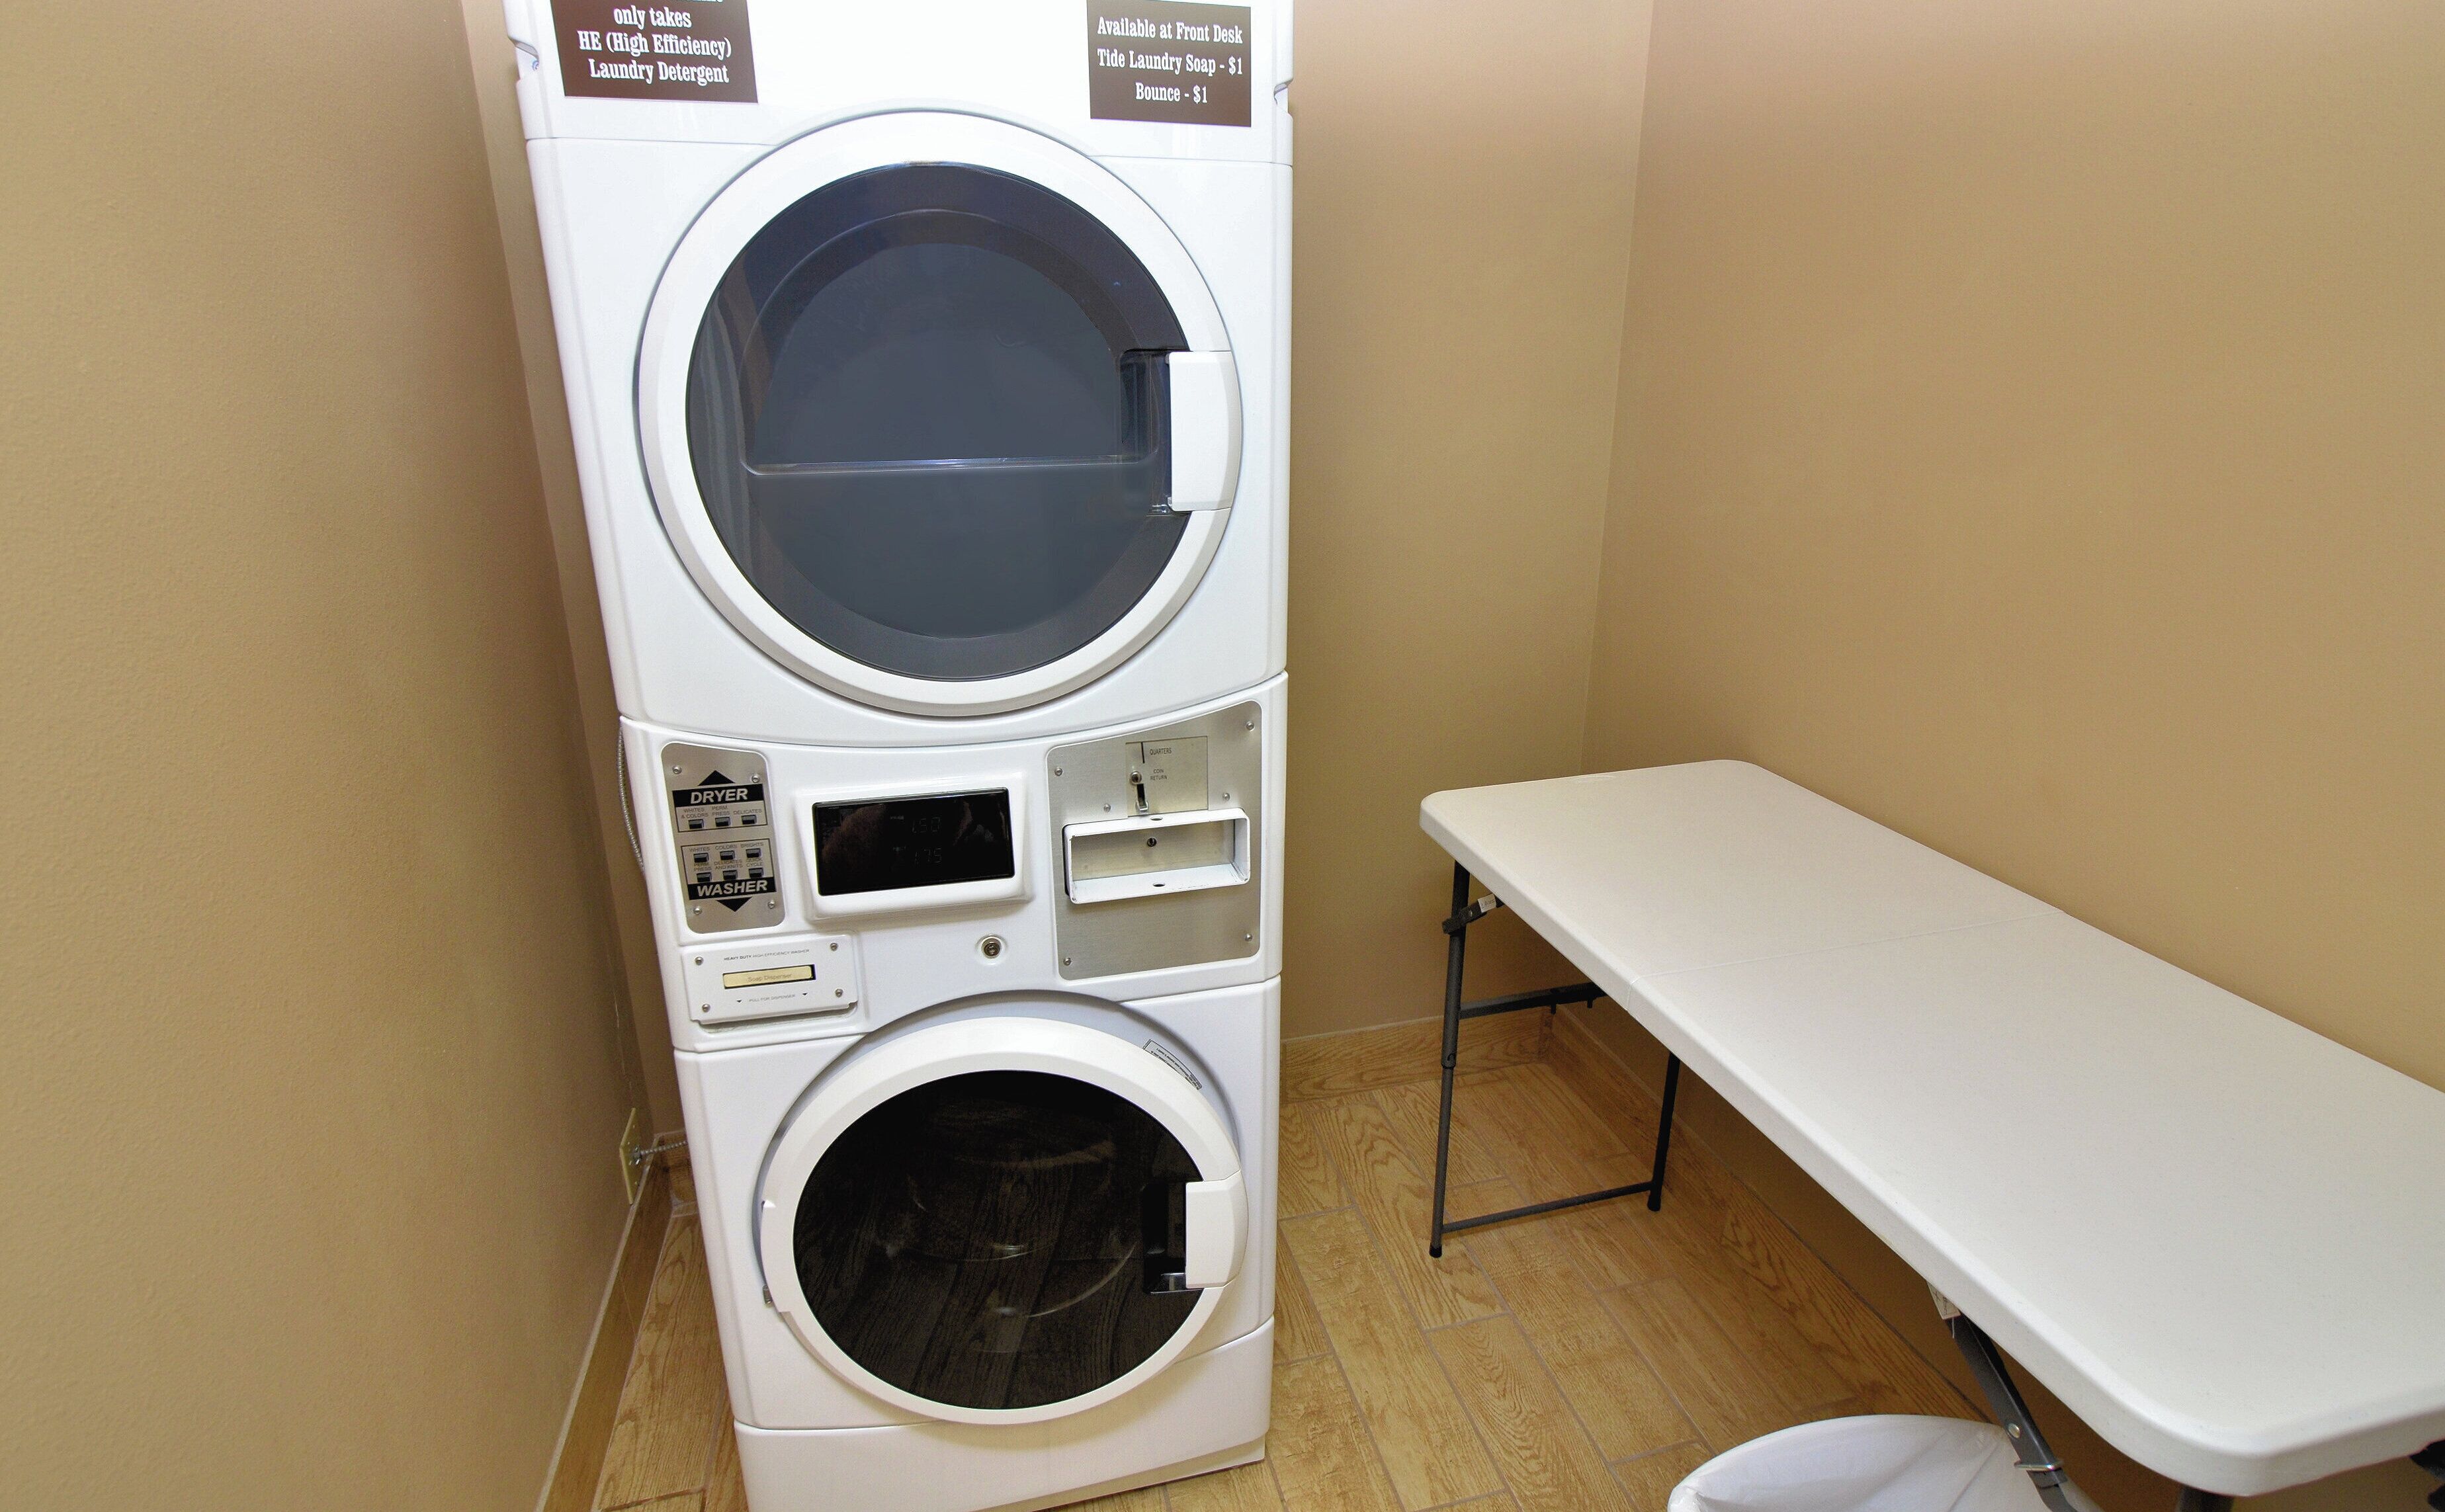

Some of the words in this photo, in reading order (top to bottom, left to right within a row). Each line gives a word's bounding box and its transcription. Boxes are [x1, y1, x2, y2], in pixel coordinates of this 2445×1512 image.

[613, 5, 646, 30] only
[648, 7, 692, 28] takes
[1097, 17, 1156, 38] Available
[1160, 22, 1173, 40] at
[1176, 21, 1210, 42] Front
[1213, 24, 1243, 44] Desk
[577, 30, 602, 51] HE
[606, 32, 650, 57] (High
[652, 34, 732, 61] Efficiency)
[588, 58, 654, 85] Laundry
[657, 61, 730, 87] Detergent
[1097, 48, 1127, 68] Tide
[1129, 50, 1183, 75] Laundry
[1185, 54, 1216, 77] Soap
[1228, 56, 1243, 75] $1
[1135, 82, 1181, 102] Bounce
[1193, 85, 1208, 104] $1
[691, 788, 748, 804] DRYER
[697, 880, 768, 897] WASHER
